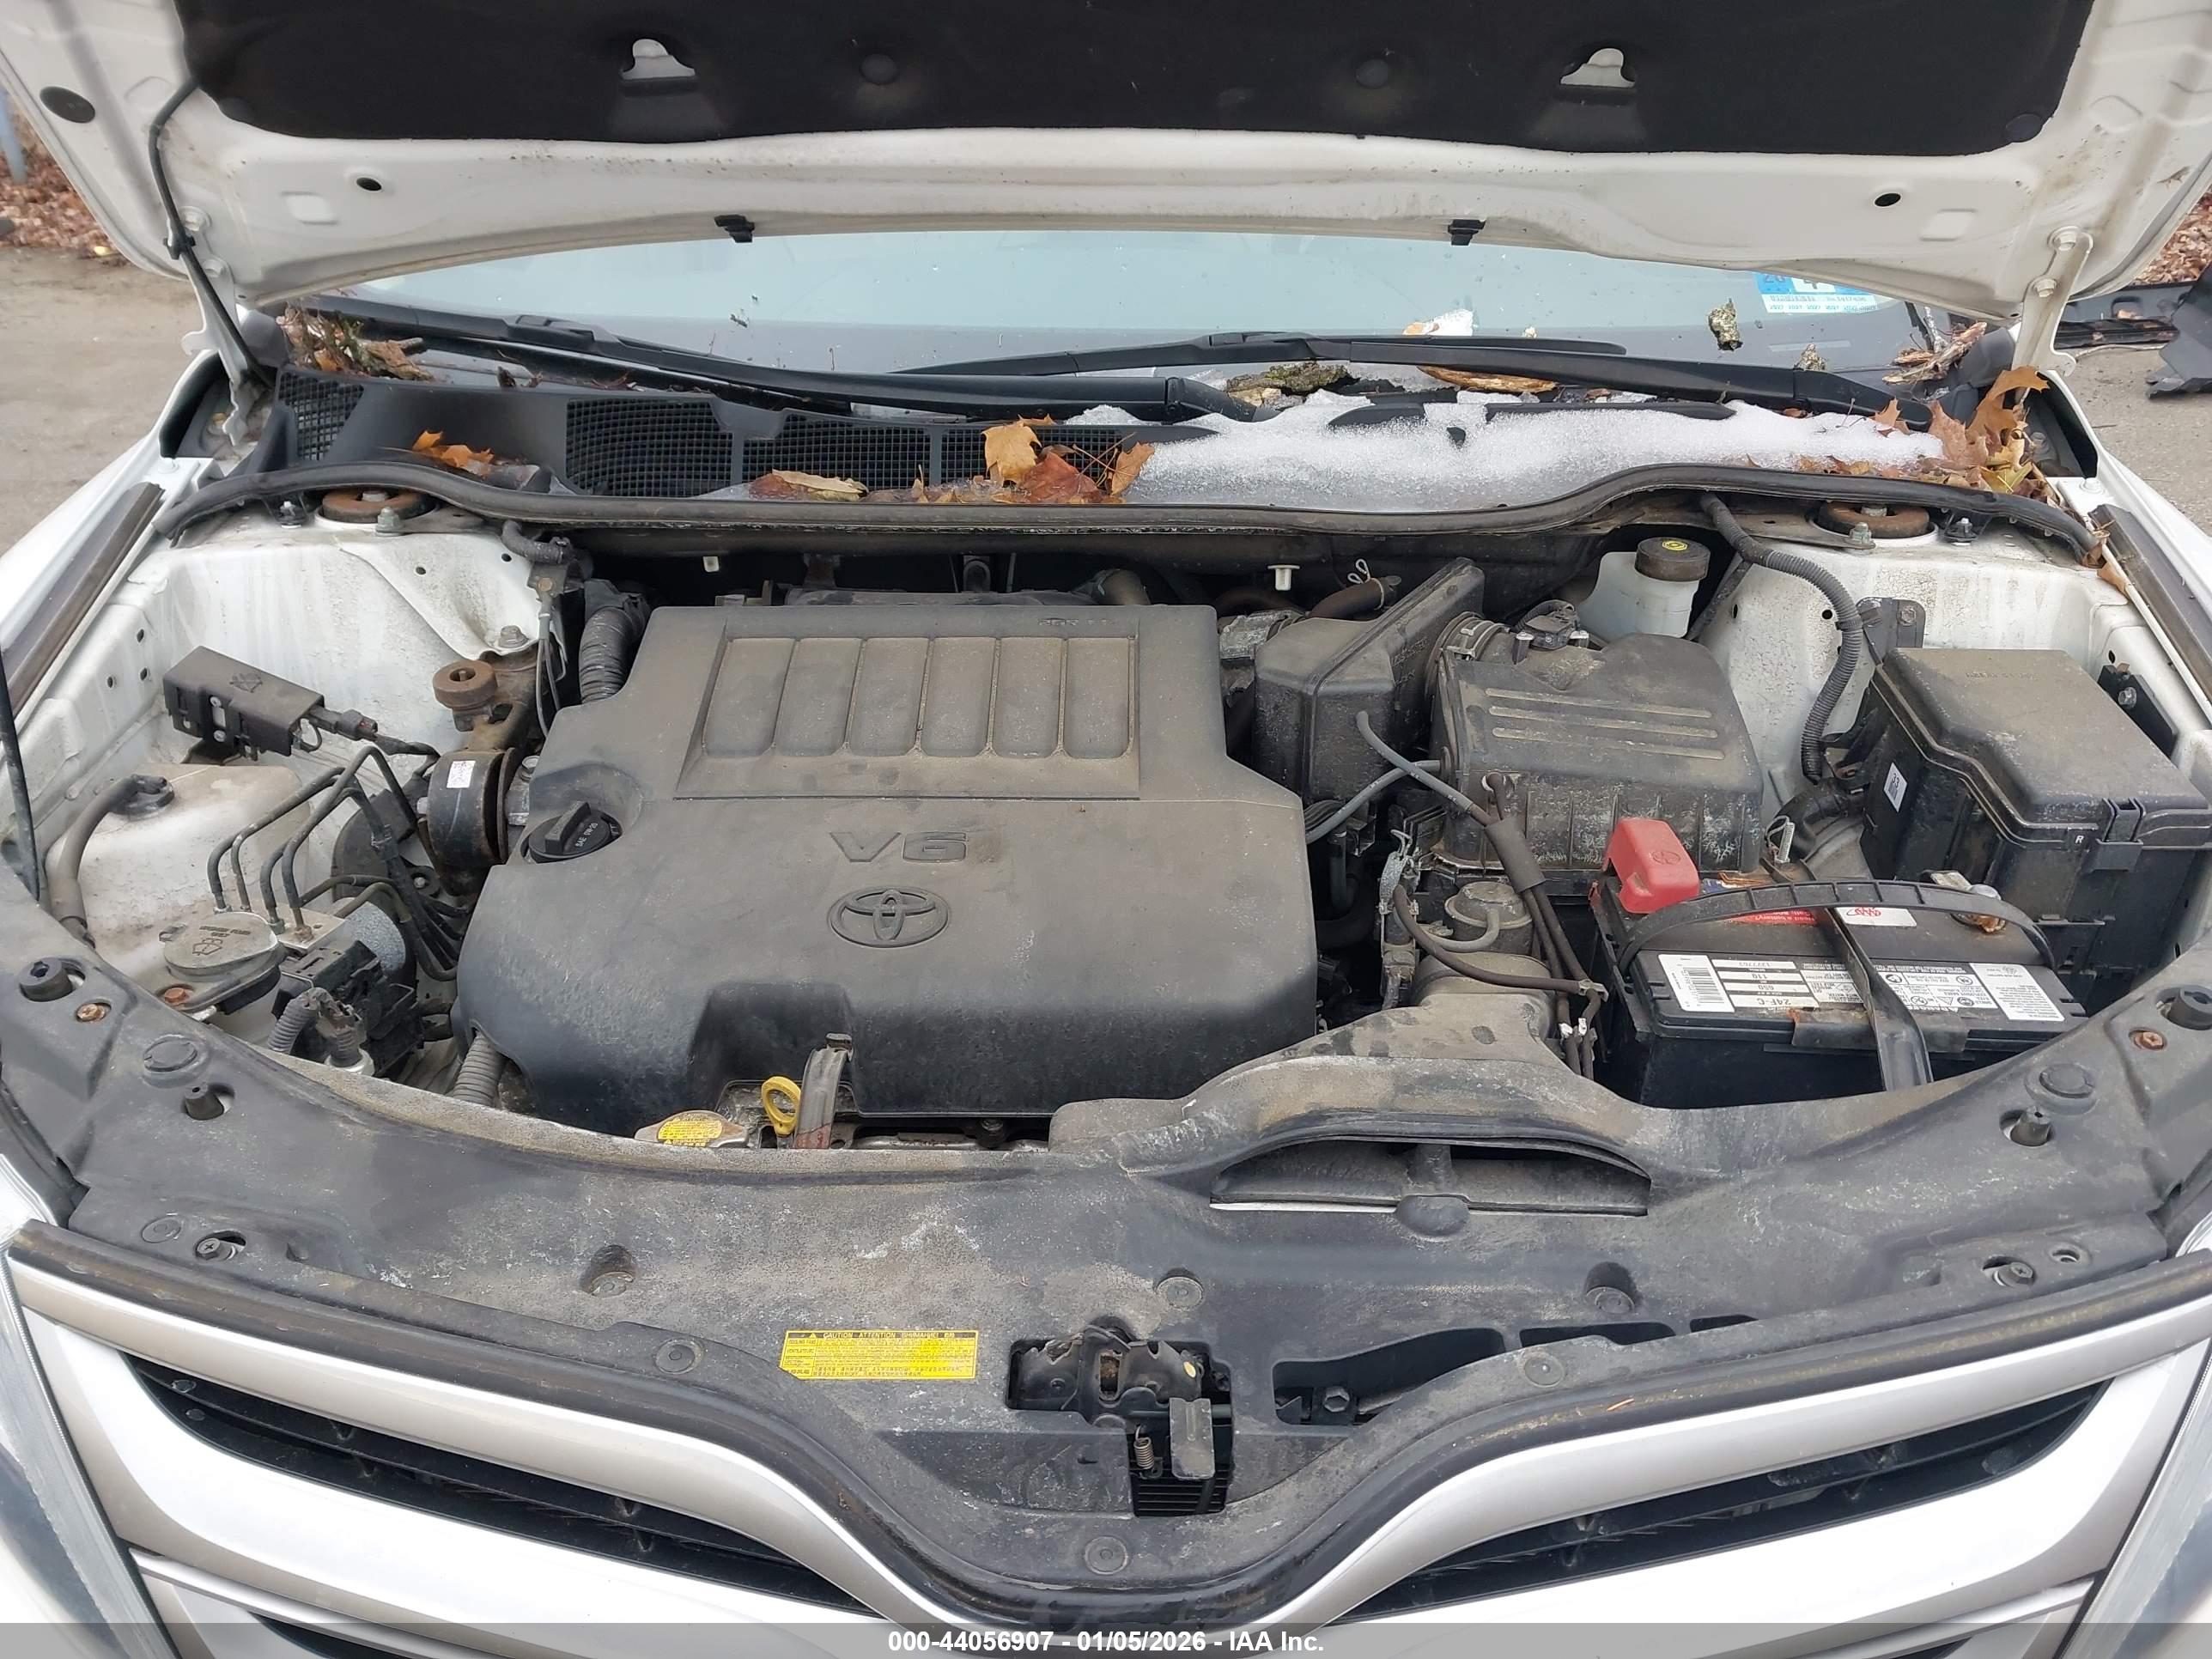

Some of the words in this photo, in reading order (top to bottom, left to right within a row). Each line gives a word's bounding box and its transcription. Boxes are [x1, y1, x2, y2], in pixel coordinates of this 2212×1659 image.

[2075, 835, 2085, 844] R
[829, 831, 968, 864] V6
[1756, 998, 1792, 1006] 24F-C
